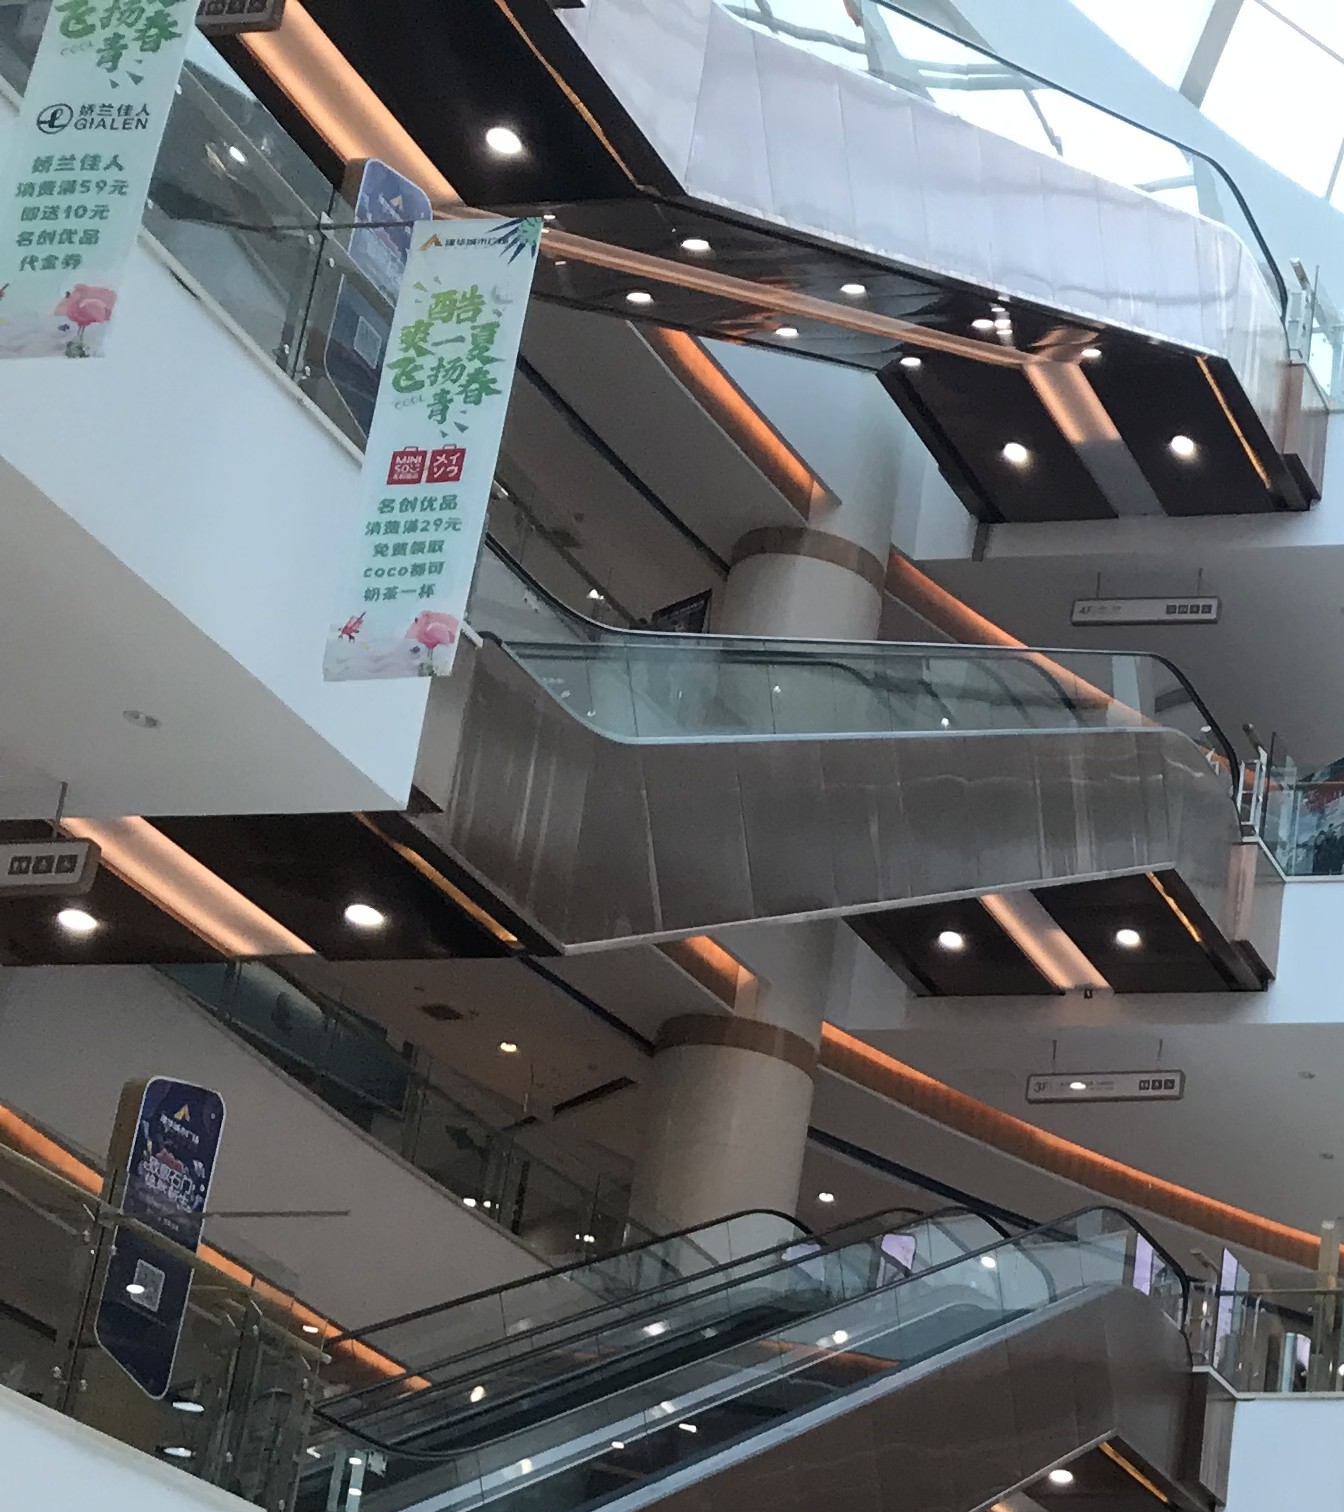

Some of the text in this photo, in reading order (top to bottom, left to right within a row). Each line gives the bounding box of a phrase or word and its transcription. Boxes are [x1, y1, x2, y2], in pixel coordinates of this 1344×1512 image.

[79, 103, 150, 117] 娇兰佳人
[74, 117, 149, 131] GIALEN
[31, 153, 125, 174] 娇兰佳人
[15, 179, 129, 198] 消费满59元
[20, 204, 111, 222] 即送10元
[16, 228, 101, 247] 名创优品
[19, 253, 83, 272] 代金券
[377, 494, 458, 514] 名创优品
[364, 517, 463, 536] 消费满29元
[372, 539, 445, 558] 免费领取
[363, 560, 446, 578] coco都可
[364, 584, 436, 602] 奶茶一杯
